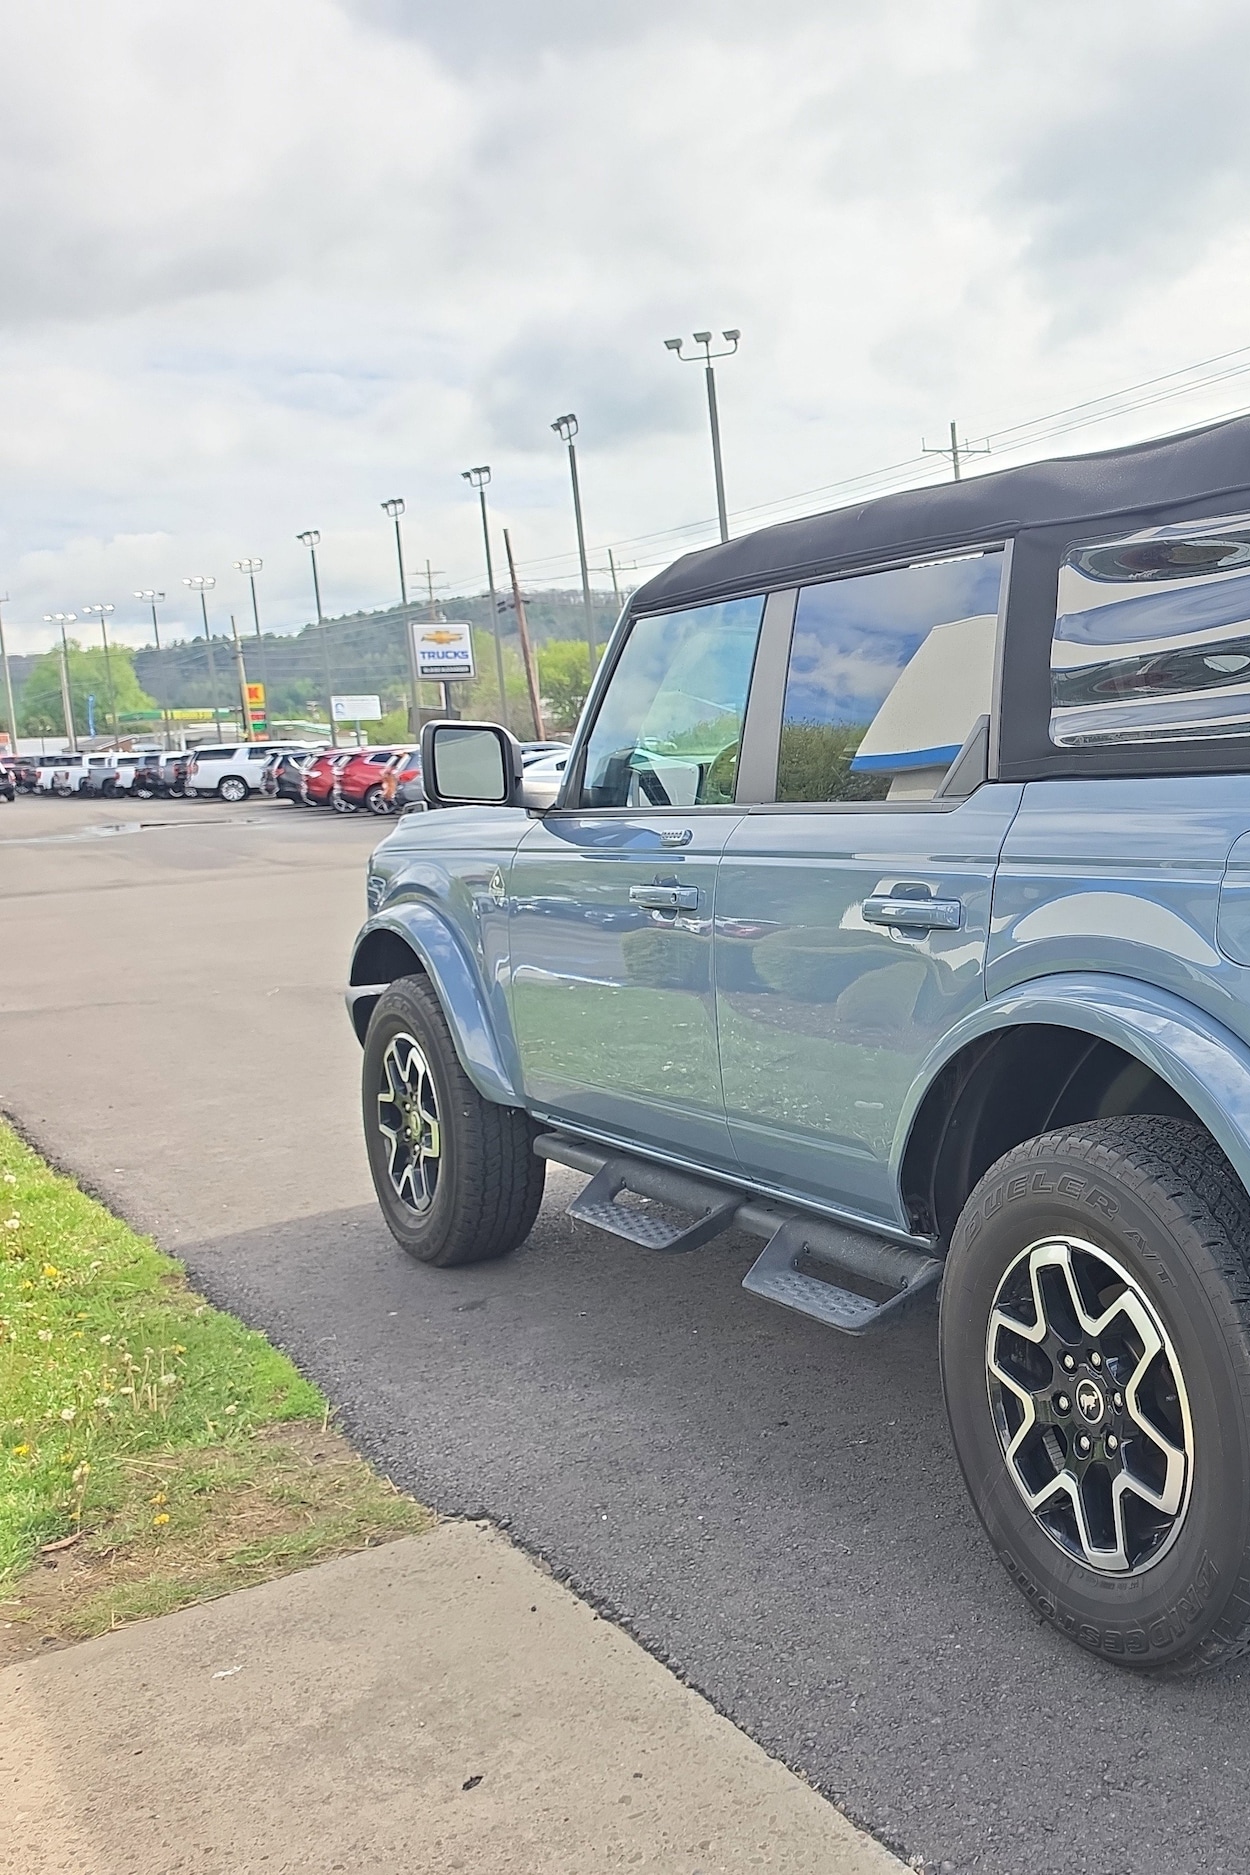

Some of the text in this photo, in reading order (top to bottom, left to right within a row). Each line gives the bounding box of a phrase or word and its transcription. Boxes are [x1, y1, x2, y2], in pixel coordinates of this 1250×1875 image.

[419, 650, 469, 660] TRUCKS
[964, 1168, 1179, 1289] DUELER A/T
